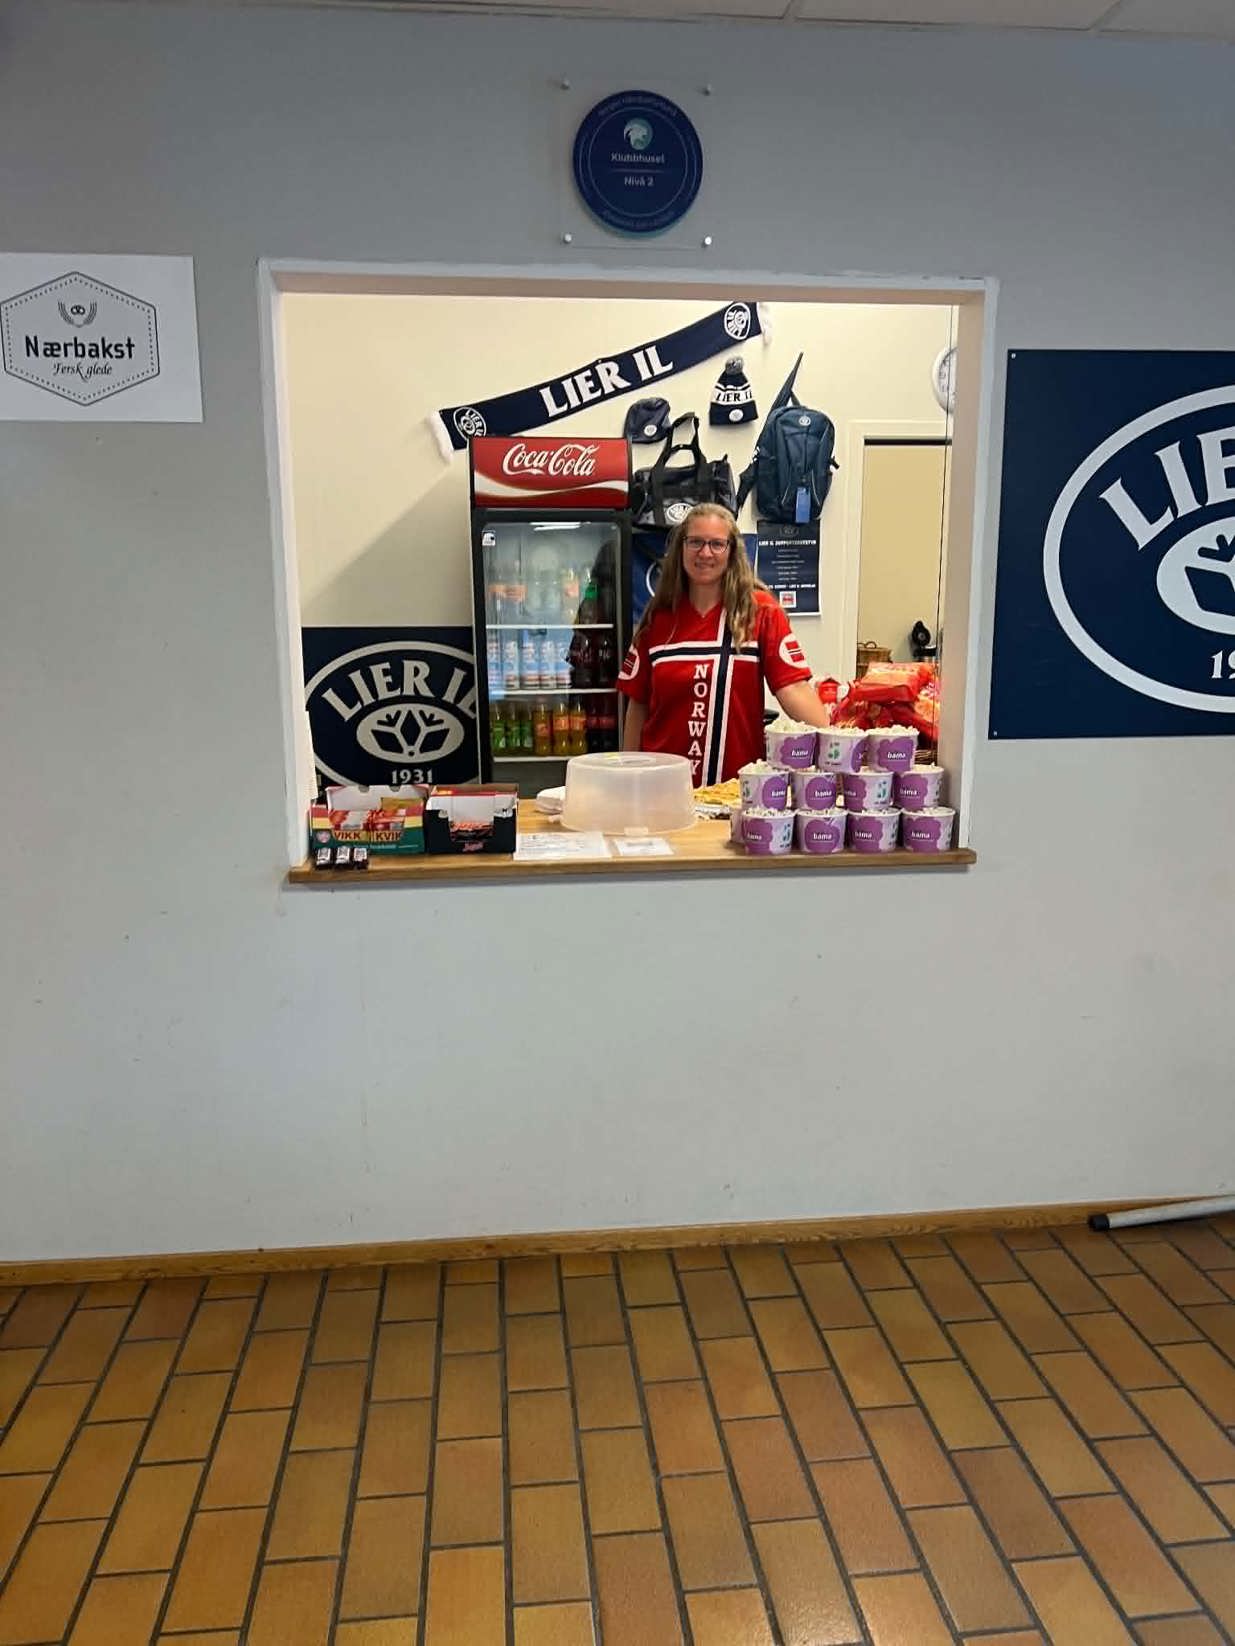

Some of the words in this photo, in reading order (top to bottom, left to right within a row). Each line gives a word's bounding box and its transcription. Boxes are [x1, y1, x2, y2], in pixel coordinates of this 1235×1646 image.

[624, 176, 646, 187] Nivå
[647, 176, 655, 187] 2
[24, 335, 136, 360] Nærbakst
[53, 362, 88, 383] Fersk
[86, 363, 113, 380] glede
[538, 359, 632, 418] LIER
[631, 344, 674, 381] IL
[715, 391, 741, 403] LIER
[502, 442, 600, 477] Coca-Cola
[321, 659, 436, 723] LIER
[441, 667, 477, 720] IL
[687, 664, 710, 776] NORWAY
[887, 750, 906, 760] bama
[391, 768, 433, 784] 1931
[334, 830, 361, 840] VIKK
[376, 830, 403, 841] KVIK
[813, 832, 832, 841] bama
